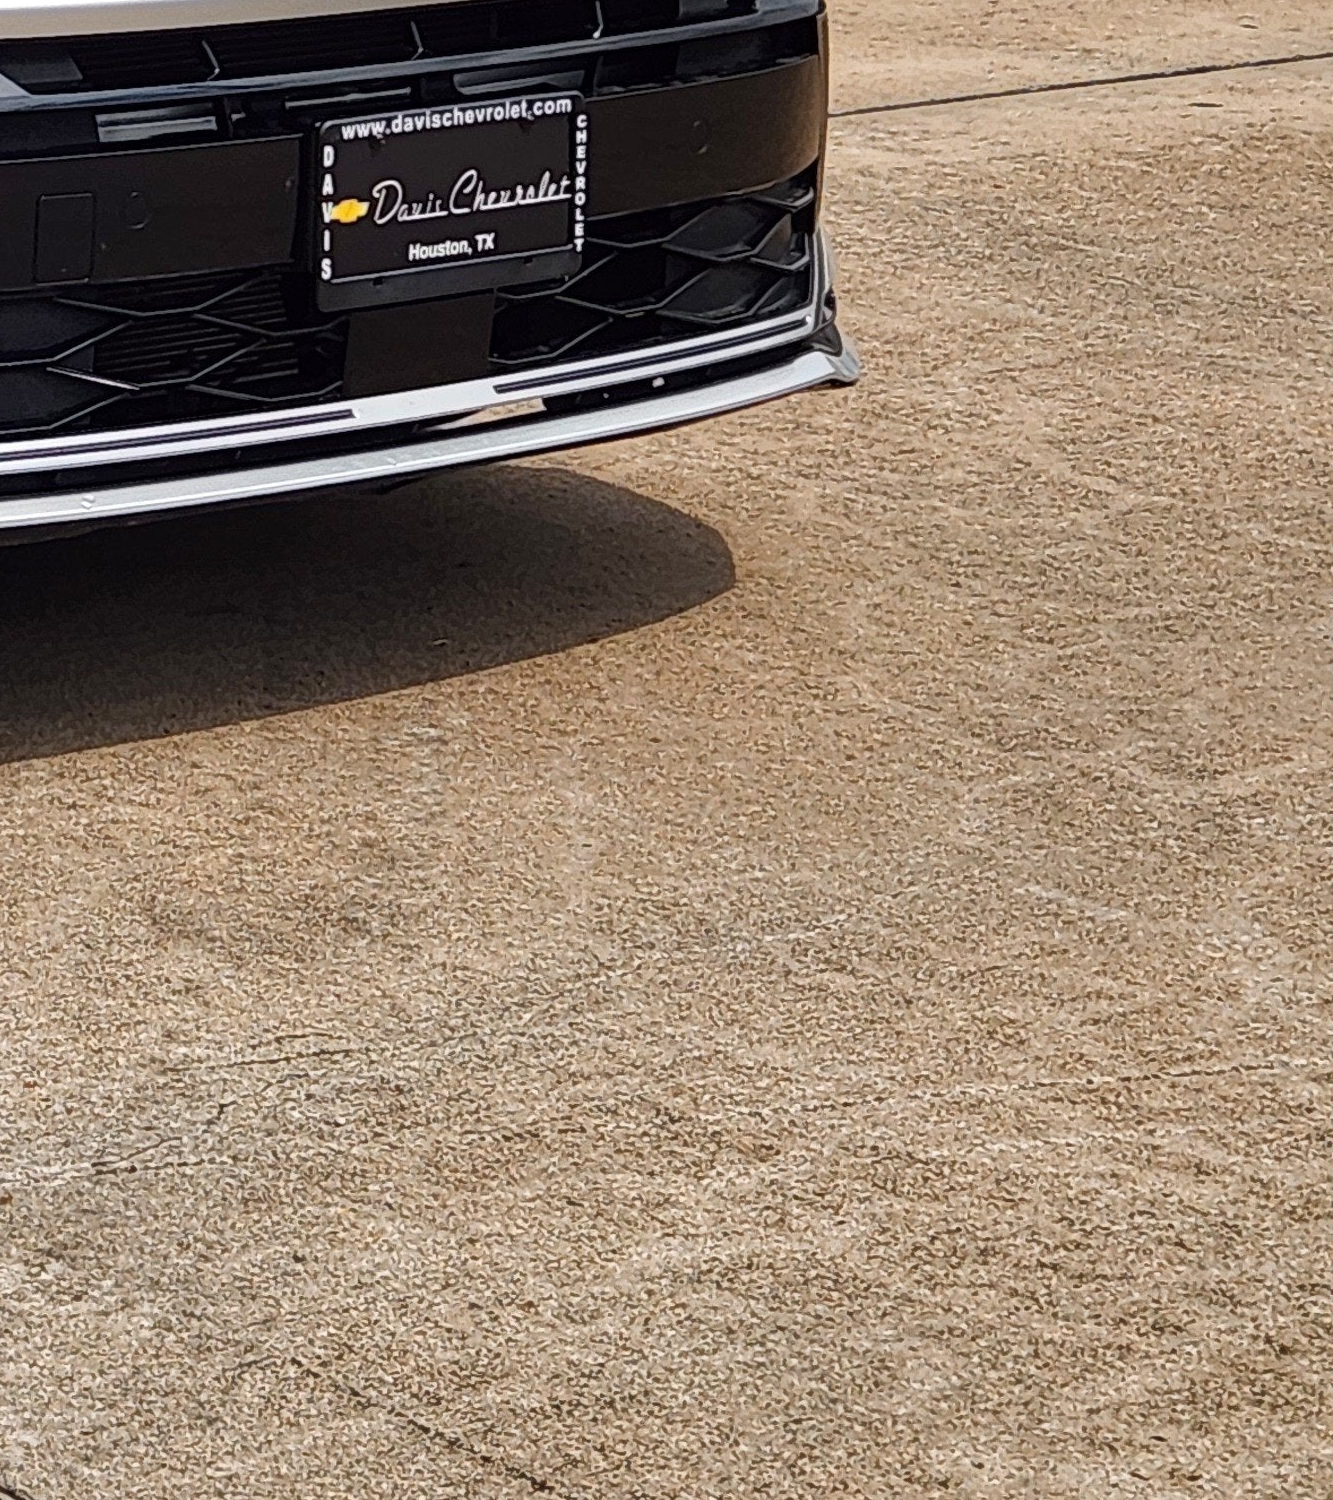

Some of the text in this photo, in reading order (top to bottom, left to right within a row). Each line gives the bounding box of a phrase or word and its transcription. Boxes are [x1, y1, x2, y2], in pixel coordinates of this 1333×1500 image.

[341, 99, 572, 140] www.davischevrolet.com
[372, 169, 572, 225] Davis Chevrolet
[575, 114, 587, 252] CHEVROLET
[321, 145, 334, 281] DAVIS
[408, 232, 496, 261] Houston, TX
